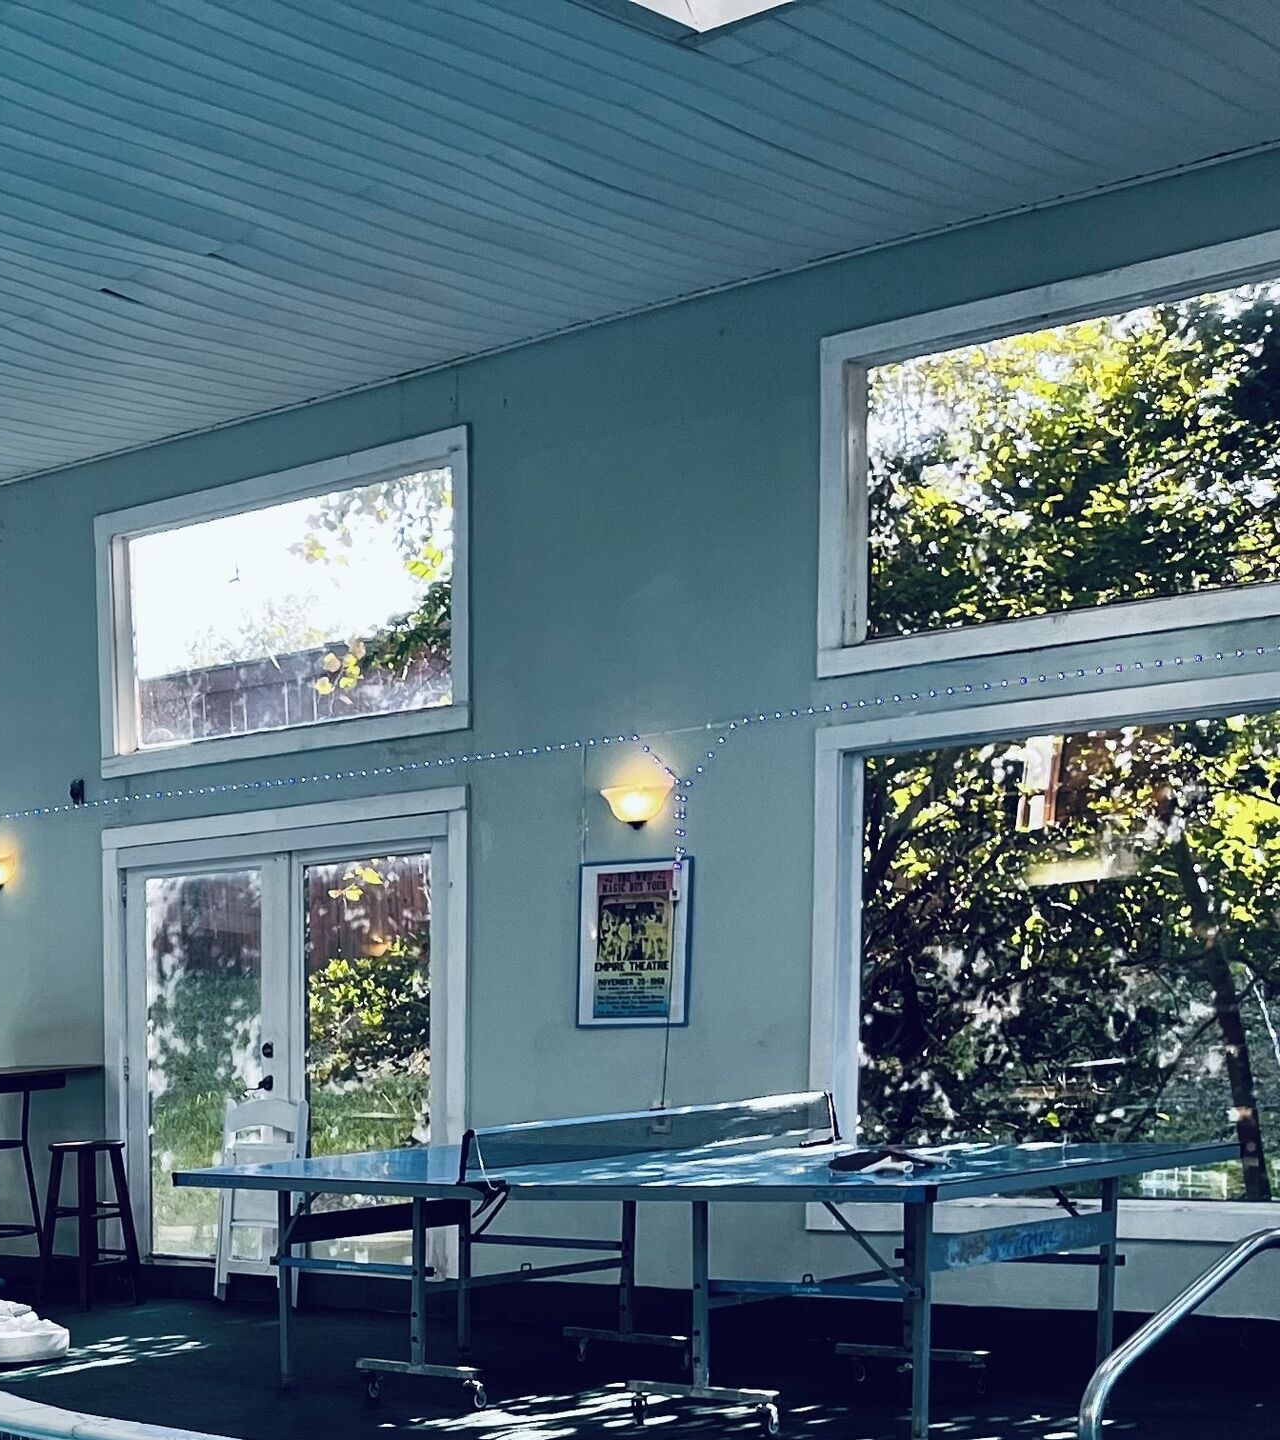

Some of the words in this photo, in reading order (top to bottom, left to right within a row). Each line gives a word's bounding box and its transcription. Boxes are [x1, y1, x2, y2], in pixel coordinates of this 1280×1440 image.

[602, 882, 627, 894] MAGIC
[629, 881, 644, 893] BUS
[647, 880, 667, 891] TOUR
[594, 961, 625, 972] EMPIRE
[629, 960, 669, 971] THEATRE
[597, 978, 633, 986] NOVEMBER
